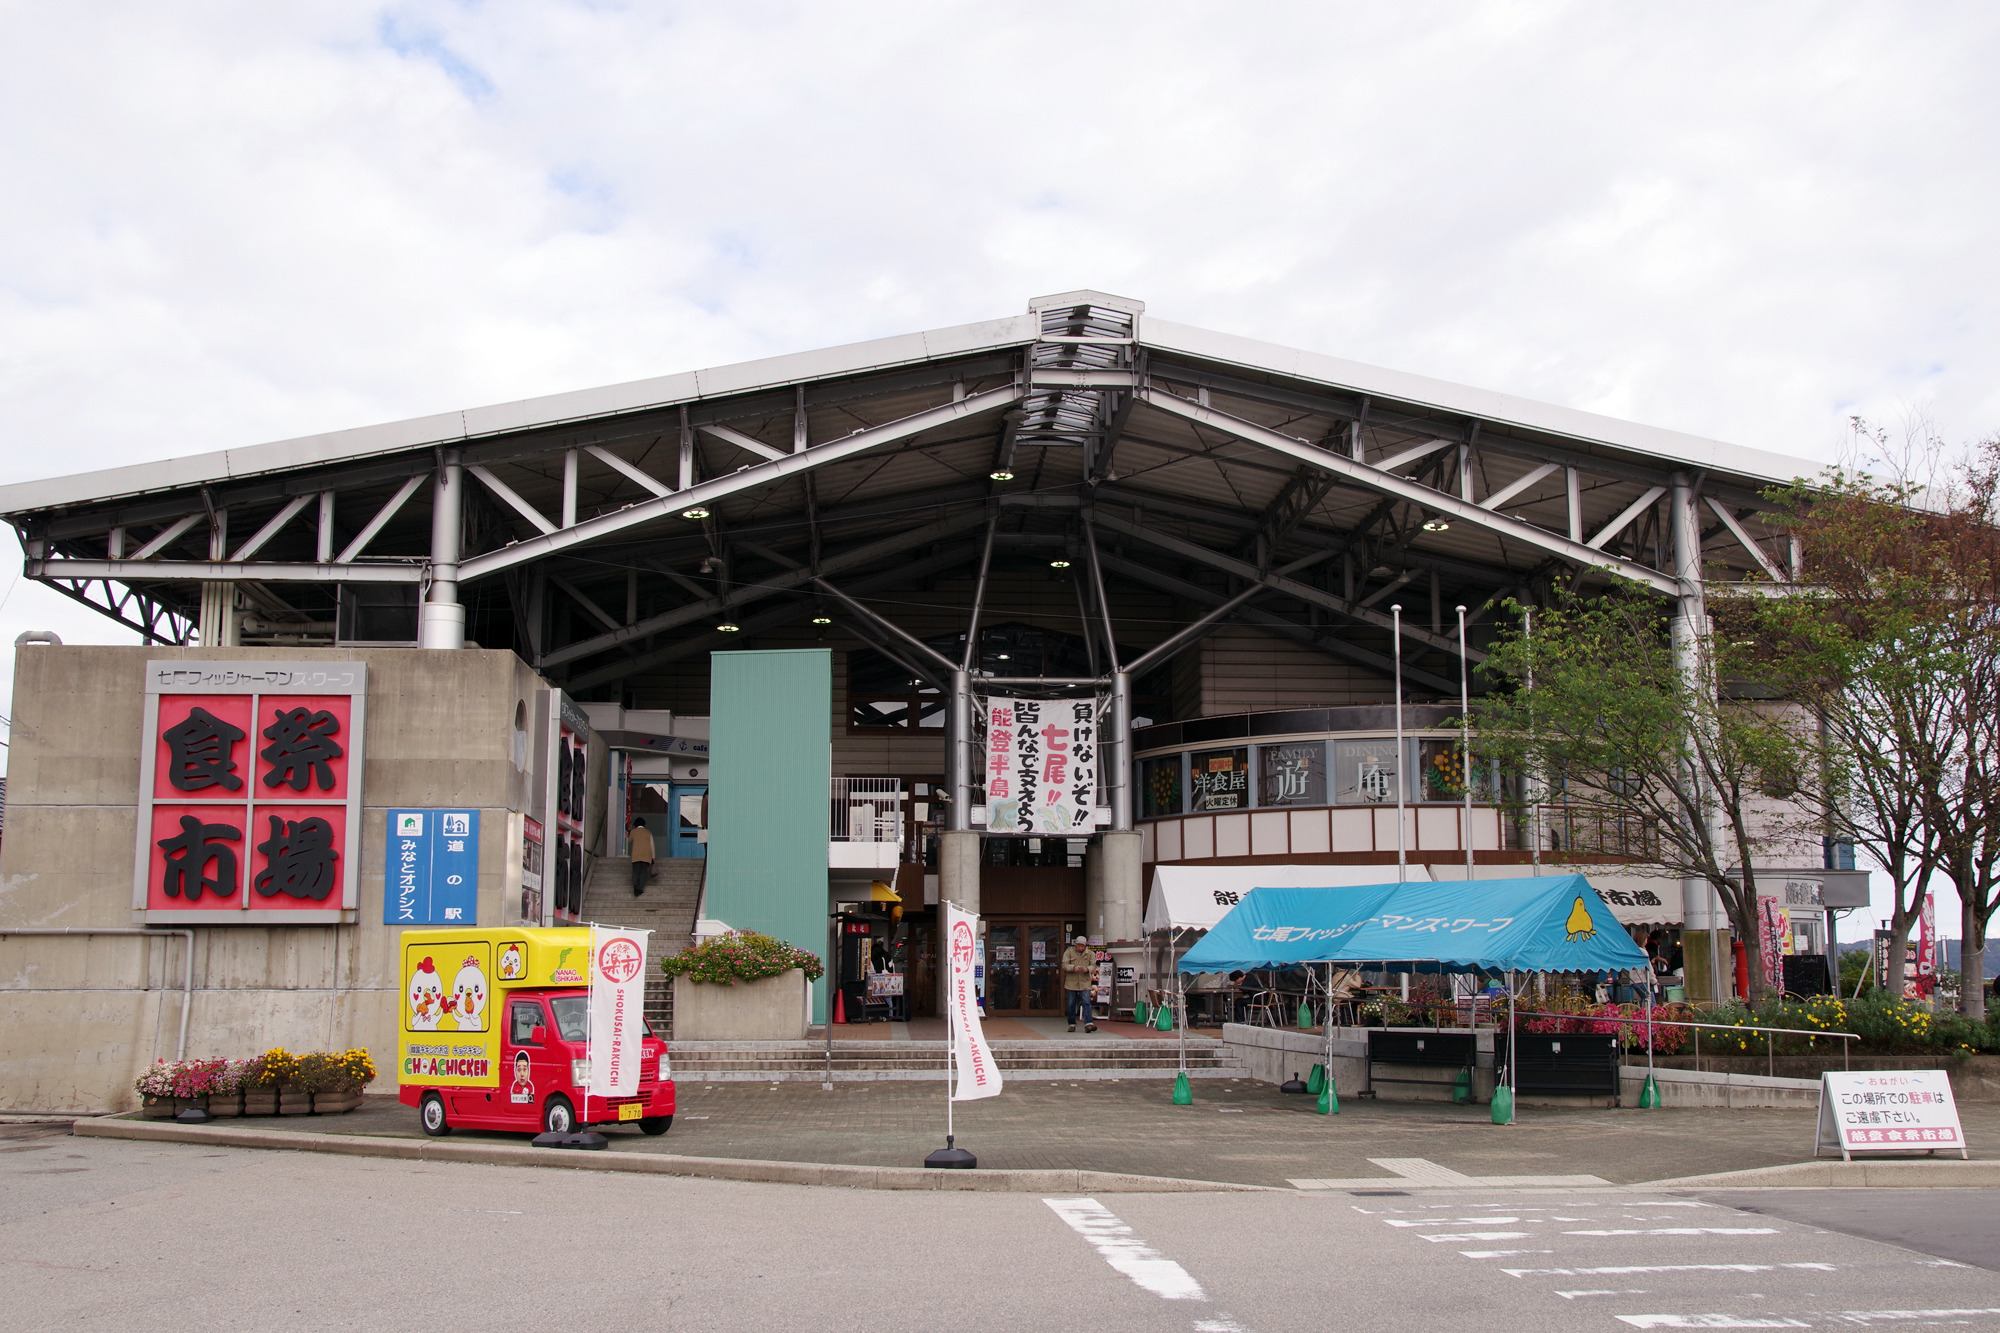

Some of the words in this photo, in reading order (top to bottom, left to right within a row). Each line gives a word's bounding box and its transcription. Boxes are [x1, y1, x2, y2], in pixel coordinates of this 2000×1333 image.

[162, 706, 344, 792] 食祭
[989, 707, 1013, 798] 能登半島
[1271, 747, 1318, 761] FAMILY
[1345, 744, 1398, 757] DINING
[1014, 701, 1041, 832] 皆んなで支えよう
[1209, 758, 1233, 771] 営業中
[1194, 769, 1247, 794] 洋食屋
[1206, 795, 1238, 808] 火曜定休
[157, 814, 338, 900] 市場
[398, 839, 417, 920] みなとオアシス
[444, 840, 465, 920] 道の駅
[1213, 889, 1248, 907] 能
[404, 1057, 488, 1077] CHOACHICKEN
[1868, 1077, 1909, 1086] おねがい
[1841, 1091, 1946, 1105] この場所での駐車は
[1845, 1110, 1921, 1124] ご遠慮下さい。
[1851, 1128, 1954, 1142] 能登食祭市場
